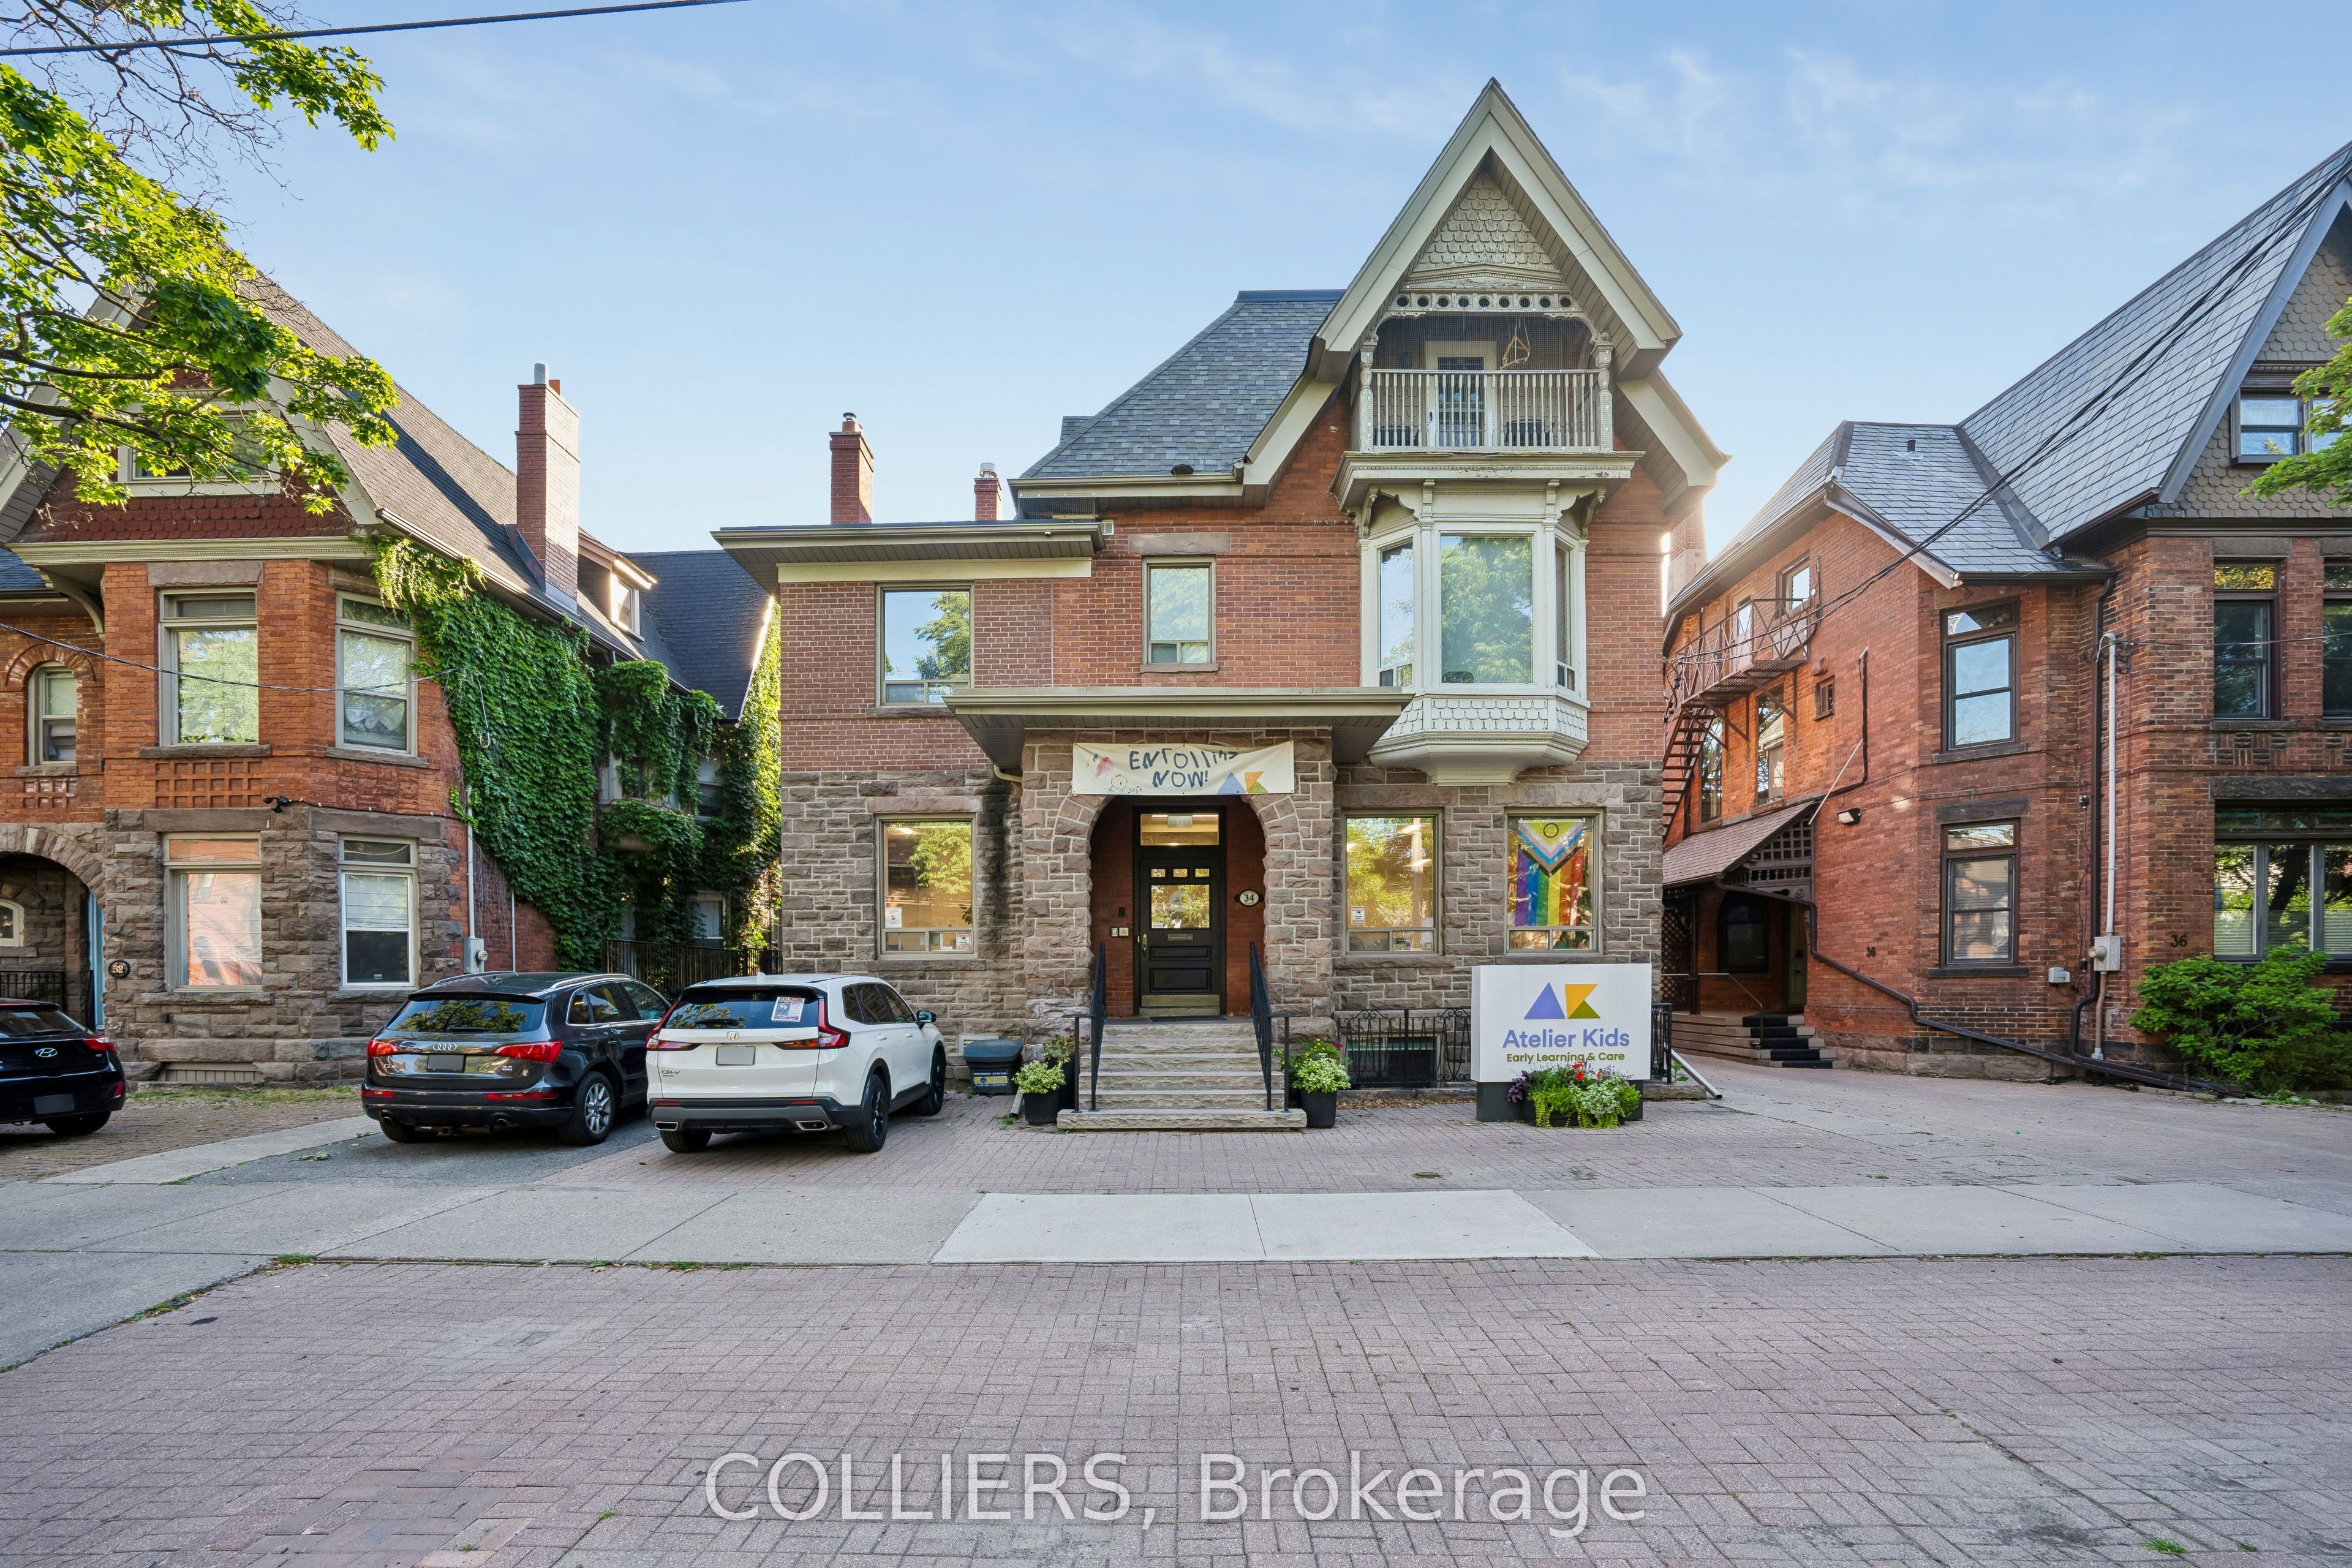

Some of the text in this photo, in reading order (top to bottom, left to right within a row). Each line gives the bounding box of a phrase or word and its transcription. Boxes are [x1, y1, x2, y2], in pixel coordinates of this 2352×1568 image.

[1152, 770, 1208, 788] NOW!
[2170, 935, 2187, 947] 36
[1866, 947, 1876, 957] 36
[1502, 1028, 1630, 1048] Atelier Kids
[1507, 1052, 1625, 1065] Early Learning & Care
